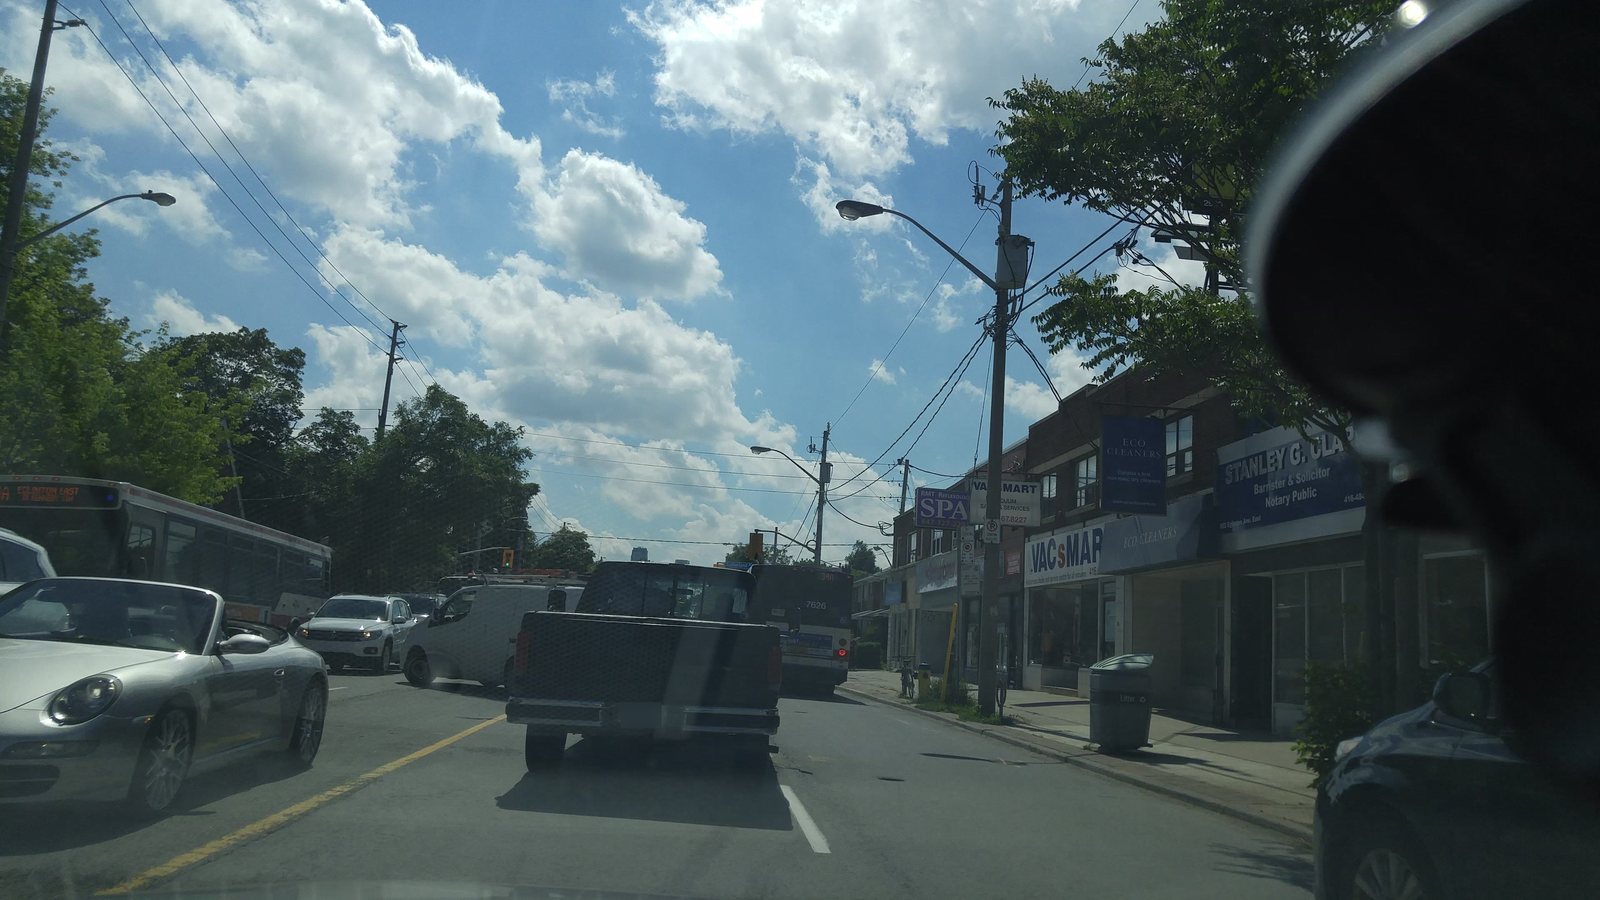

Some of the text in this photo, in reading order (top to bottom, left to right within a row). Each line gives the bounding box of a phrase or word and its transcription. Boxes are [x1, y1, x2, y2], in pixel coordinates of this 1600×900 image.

[1123, 438, 1146, 447] ECO
[1107, 447, 1161, 458] CLEANERS
[1225, 447, 1287, 485] STANLEY
[1254, 467, 1329, 495] Barrister & Solicitor
[1003, 483, 1037, 494] MART
[1265, 487, 1318, 508] Notary Public
[920, 498, 968, 521] SPA
[1123, 535, 1137, 548] ECO
[806, 600, 826, 610] 7626
